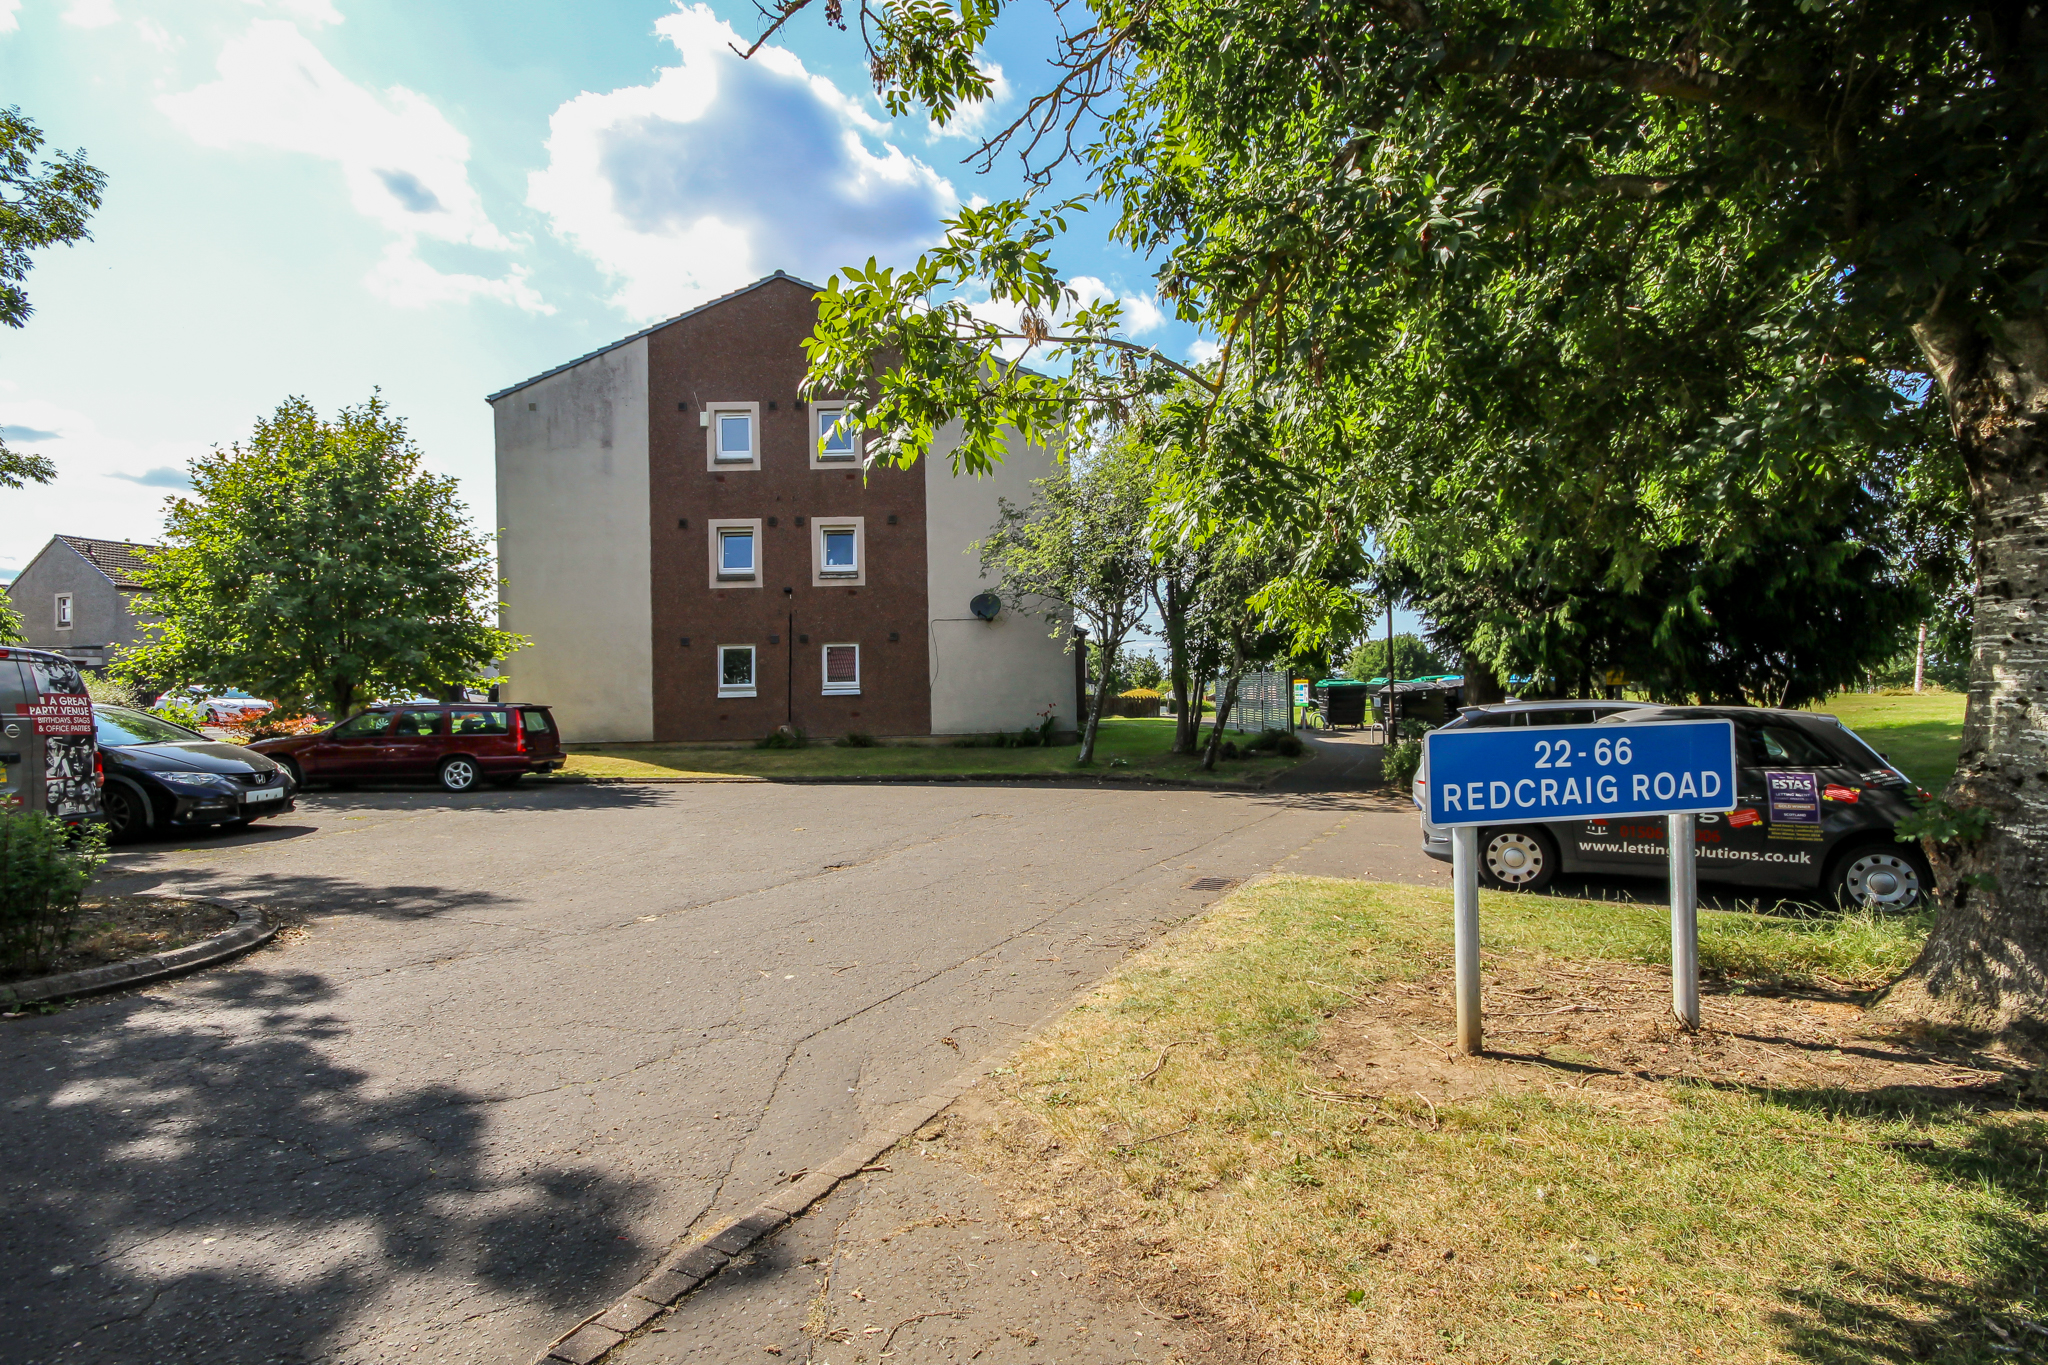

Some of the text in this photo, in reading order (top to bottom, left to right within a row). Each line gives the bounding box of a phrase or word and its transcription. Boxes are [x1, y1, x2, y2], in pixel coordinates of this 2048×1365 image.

[50, 696, 88, 706] A GREAT
[29, 706, 89, 716] PARTY VENUE
[1771, 779, 1812, 790] ESTAS
[1443, 770, 1721, 812] REDCRAIG ROAD
[1620, 825, 1663, 839] 01506
